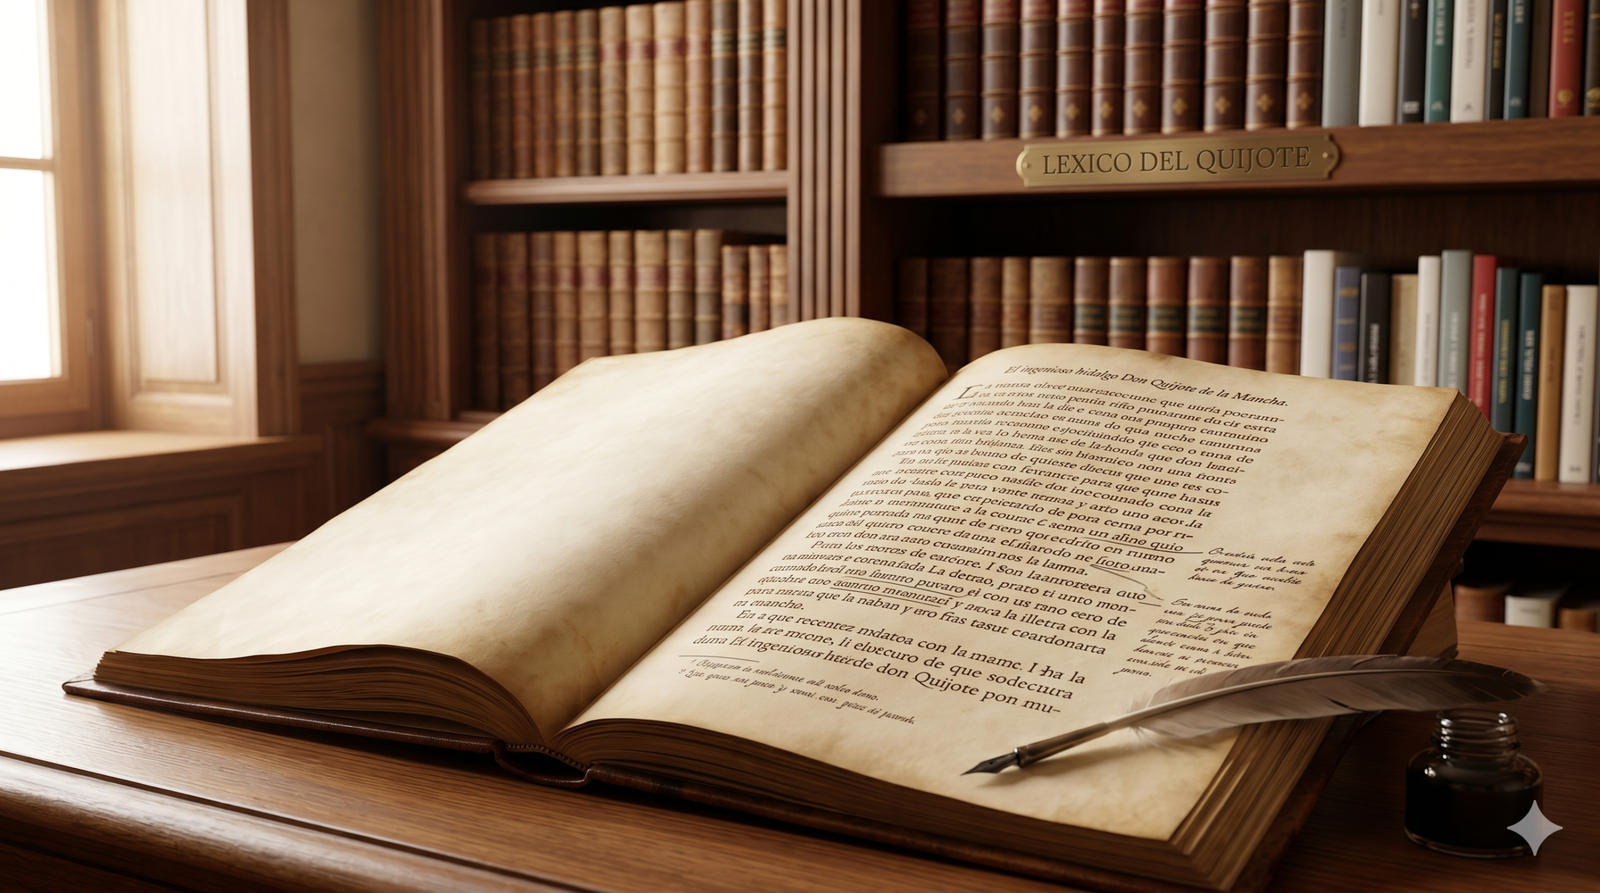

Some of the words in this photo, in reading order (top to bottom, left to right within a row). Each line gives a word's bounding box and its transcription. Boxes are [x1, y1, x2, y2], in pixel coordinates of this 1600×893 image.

[1042, 152, 1132, 175] LEXICO
[1139, 150, 1190, 172] DEL
[1196, 146, 1311, 175] QUIJOTE
[1020, 366, 1073, 374] ingenioso
[1074, 368, 1118, 380] hidalgo
[1120, 374, 1147, 383] Don
[1150, 380, 1197, 392] Quijote
[1198, 387, 1214, 395] de
[1231, 393, 1287, 406] Mancha.
[1070, 439, 1085, 447] de
[1147, 454, 1172, 462] que
[1175, 457, 1202, 467] don
[1080, 478, 1112, 488] para
[1115, 484, 1139, 492] que
[1124, 474, 1150, 482] que
[1153, 479, 1179, 487] une
[1137, 464, 1162, 472] non
[1167, 469, 1191, 477] una
[969, 519, 986, 528] de
[1048, 508, 1064, 516] de
[1067, 513, 1099, 523] pora
[1144, 528, 1172, 536] por
[1074, 501, 1087, 509] y
[1089, 505, 1118, 513] arto
[1121, 510, 1148, 519] uno
[1158, 505, 1193, 514] cona
[1197, 509, 1211, 517] la
[973, 507, 985, 515] la
[1088, 530, 1108, 538] un
[1149, 542, 1183, 554] quio
[853, 531, 877, 539] don
[1025, 556, 1038, 565] la
[909, 549, 926, 558] de
[996, 565, 1022, 576] Son
[927, 565, 944, 575] La
[996, 582, 1039, 594] prato
[1057, 594, 1092, 605] unto
[1095, 601, 1136, 612] mon-
[816, 593, 840, 601] que
[841, 593, 854, 602] la
[857, 598, 899, 610] naban
[900, 605, 913, 615] y
[970, 620, 1008, 633] tasut
[950, 597, 963, 609] y
[1002, 610, 1017, 620] la
[1019, 614, 1065, 630] illetra
[1069, 626, 1096, 636] con
[1100, 630, 1115, 640] la
[983, 593, 1009, 603] con
[1013, 599, 1031, 607] us
[1106, 617, 1126, 627] de
[766, 614, 793, 623] que
[917, 641, 946, 652] con
[950, 646, 966, 657] la
[1027, 663, 1037, 672] I
[1068, 672, 1085, 684] la
[838, 637, 851, 647] li
[923, 657, 944, 668] de
[949, 666, 982, 677] que
[876, 663, 908, 678] don
[911, 672, 978, 695] Quijote
[980, 692, 1017, 704] pon
[1022, 701, 1060, 713] mu-
